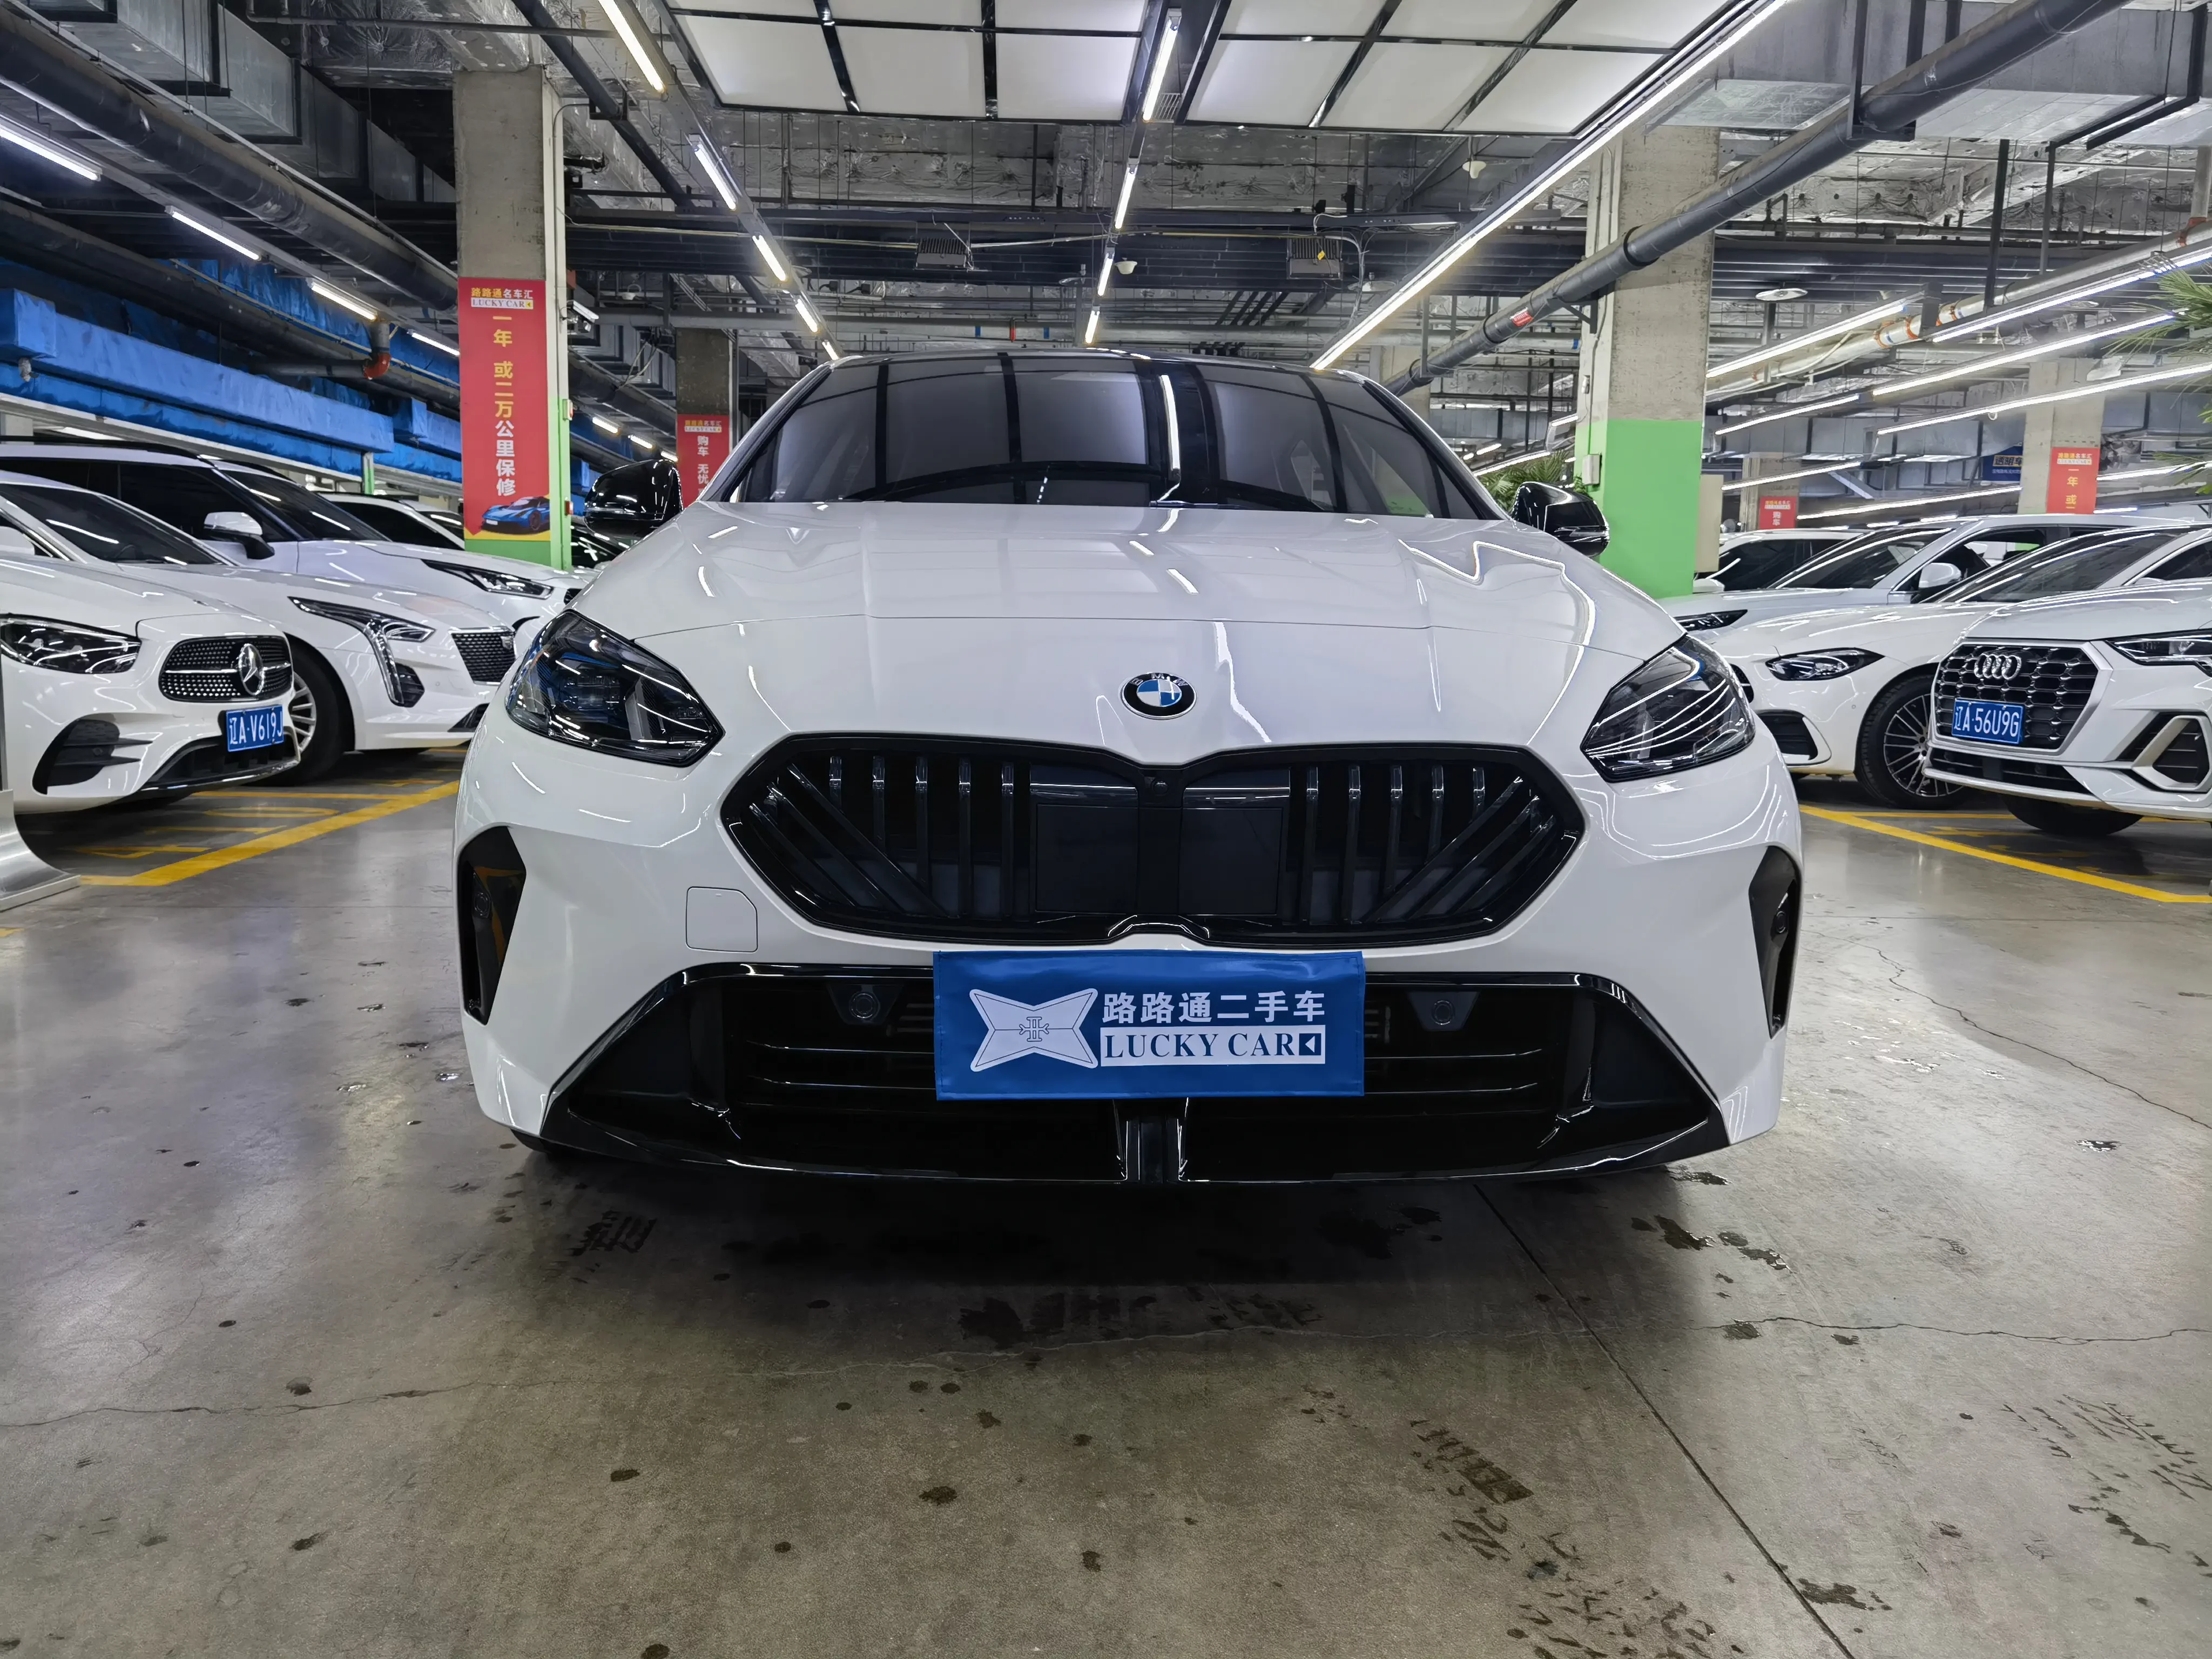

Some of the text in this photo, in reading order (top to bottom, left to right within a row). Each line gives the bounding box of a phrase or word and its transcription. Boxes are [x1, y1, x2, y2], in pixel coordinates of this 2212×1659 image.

[471, 287, 534, 299] 路路通名车汇
[1102, 990, 1325, 1023] 路路通二手车
[1104, 1033, 1295, 1058] LUCKY CAR
